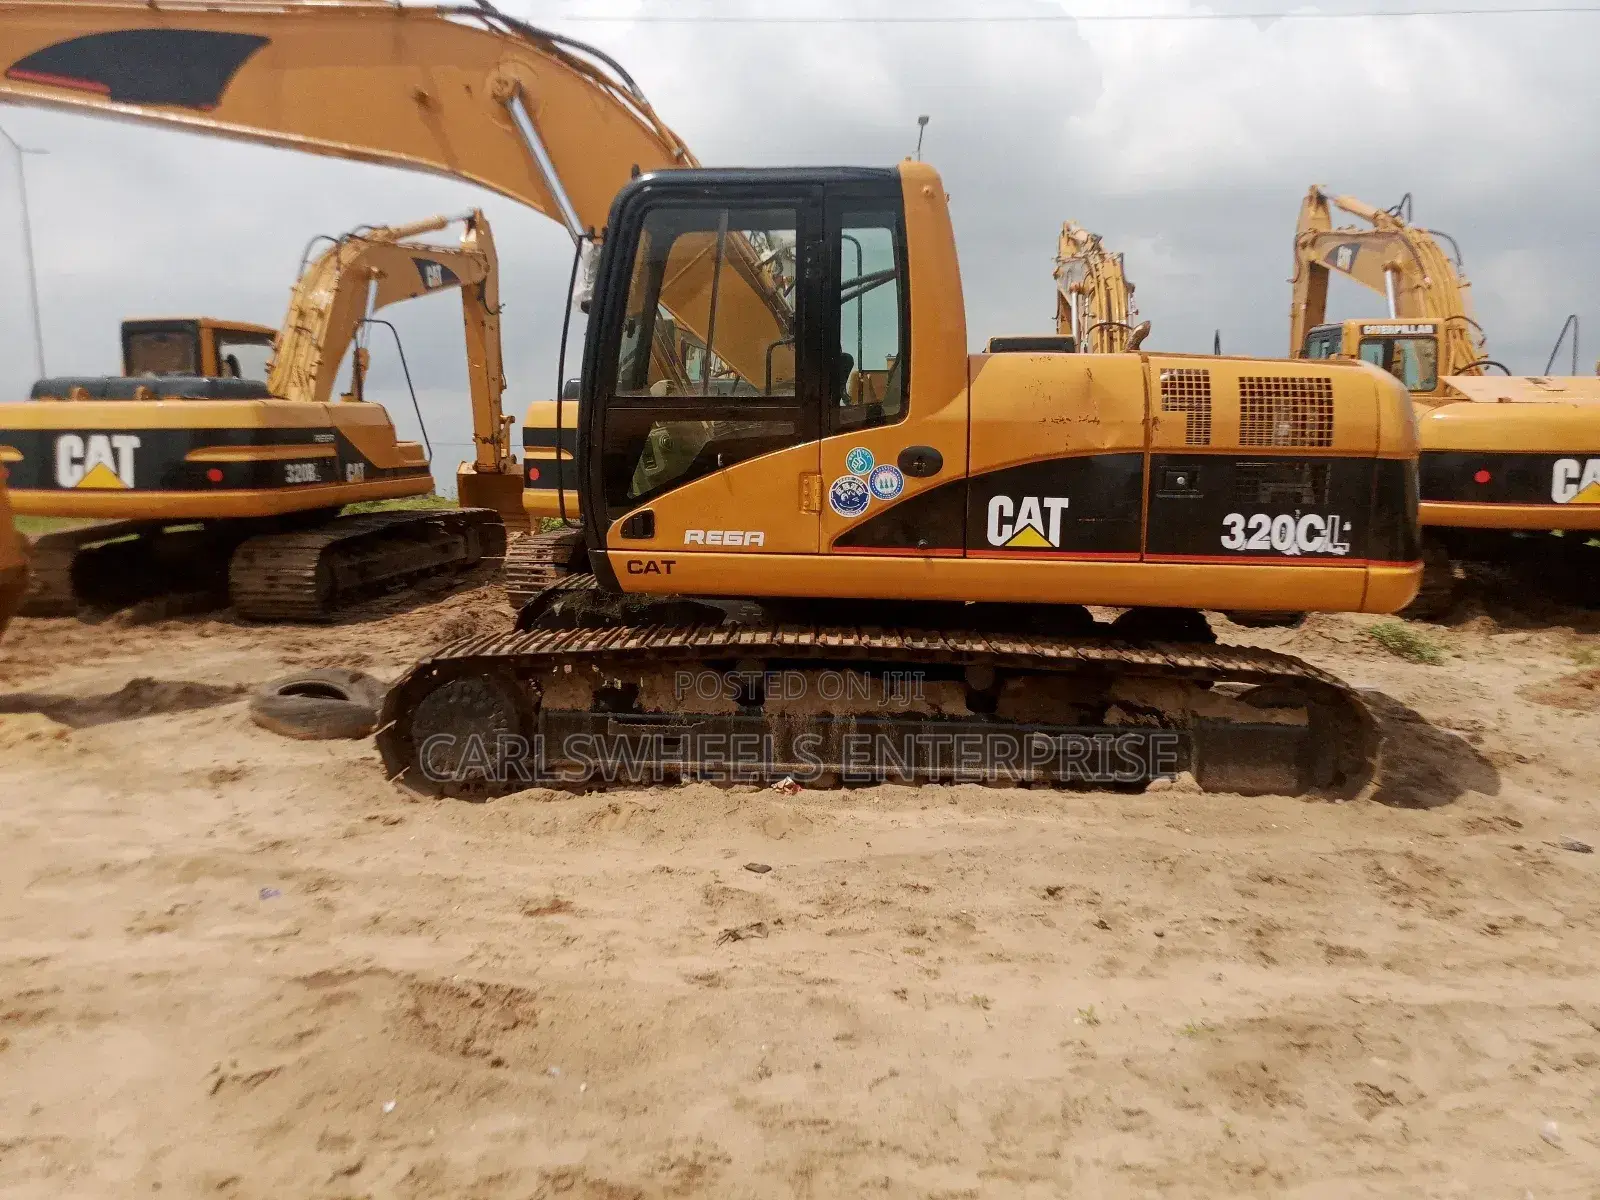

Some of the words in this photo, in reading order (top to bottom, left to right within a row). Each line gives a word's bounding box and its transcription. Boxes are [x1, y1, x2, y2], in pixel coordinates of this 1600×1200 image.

[56, 434, 141, 488] CAT
[345, 462, 364, 482] CAT
[986, 495, 1069, 548] CAT
[684, 529, 765, 546] REGA
[627, 560, 676, 574] CAT
